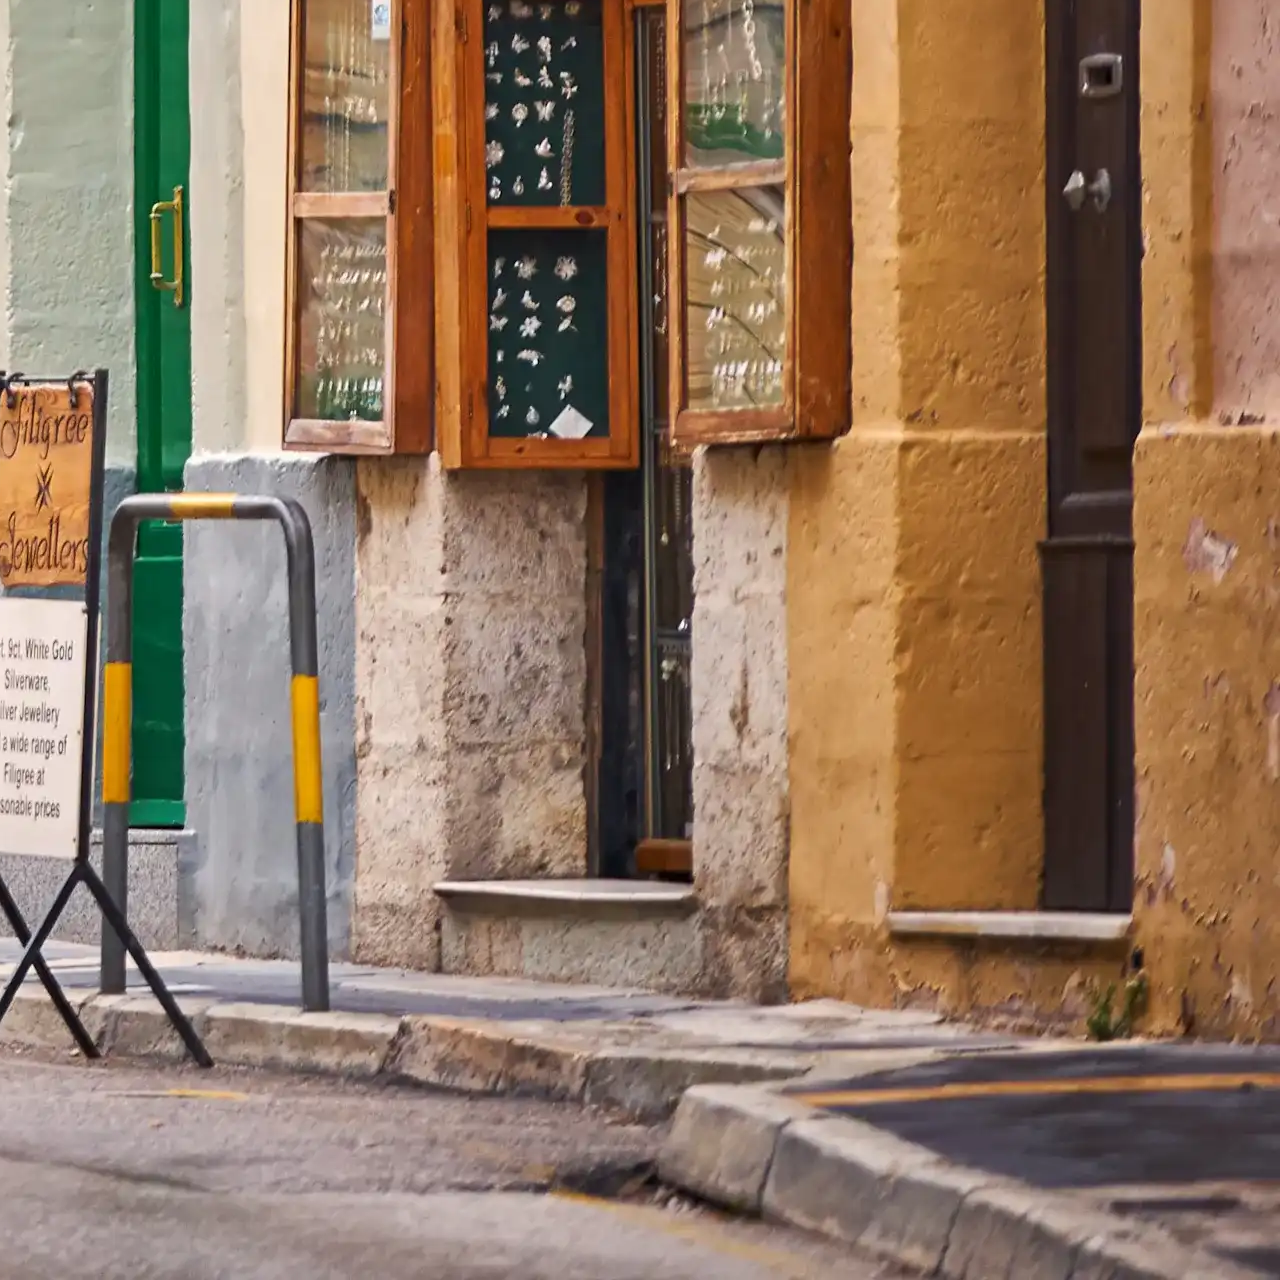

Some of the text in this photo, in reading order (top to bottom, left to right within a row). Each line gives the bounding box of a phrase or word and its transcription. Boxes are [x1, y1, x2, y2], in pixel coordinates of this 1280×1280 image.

[1, 391, 89, 460] Filigree
[25, 638, 49, 660] White
[52, 639, 74, 661] Gold
[4, 668, 51, 695] Silverware,
[19, 699, 61, 729] Jewellery
[2, 735, 8, 752] a
[10, 731, 29, 753] wide
[31, 737, 55, 760] range
[58, 733, 68, 756] of
[4, 762, 46, 790] Filigree at
[34, 796, 61, 821] prices
